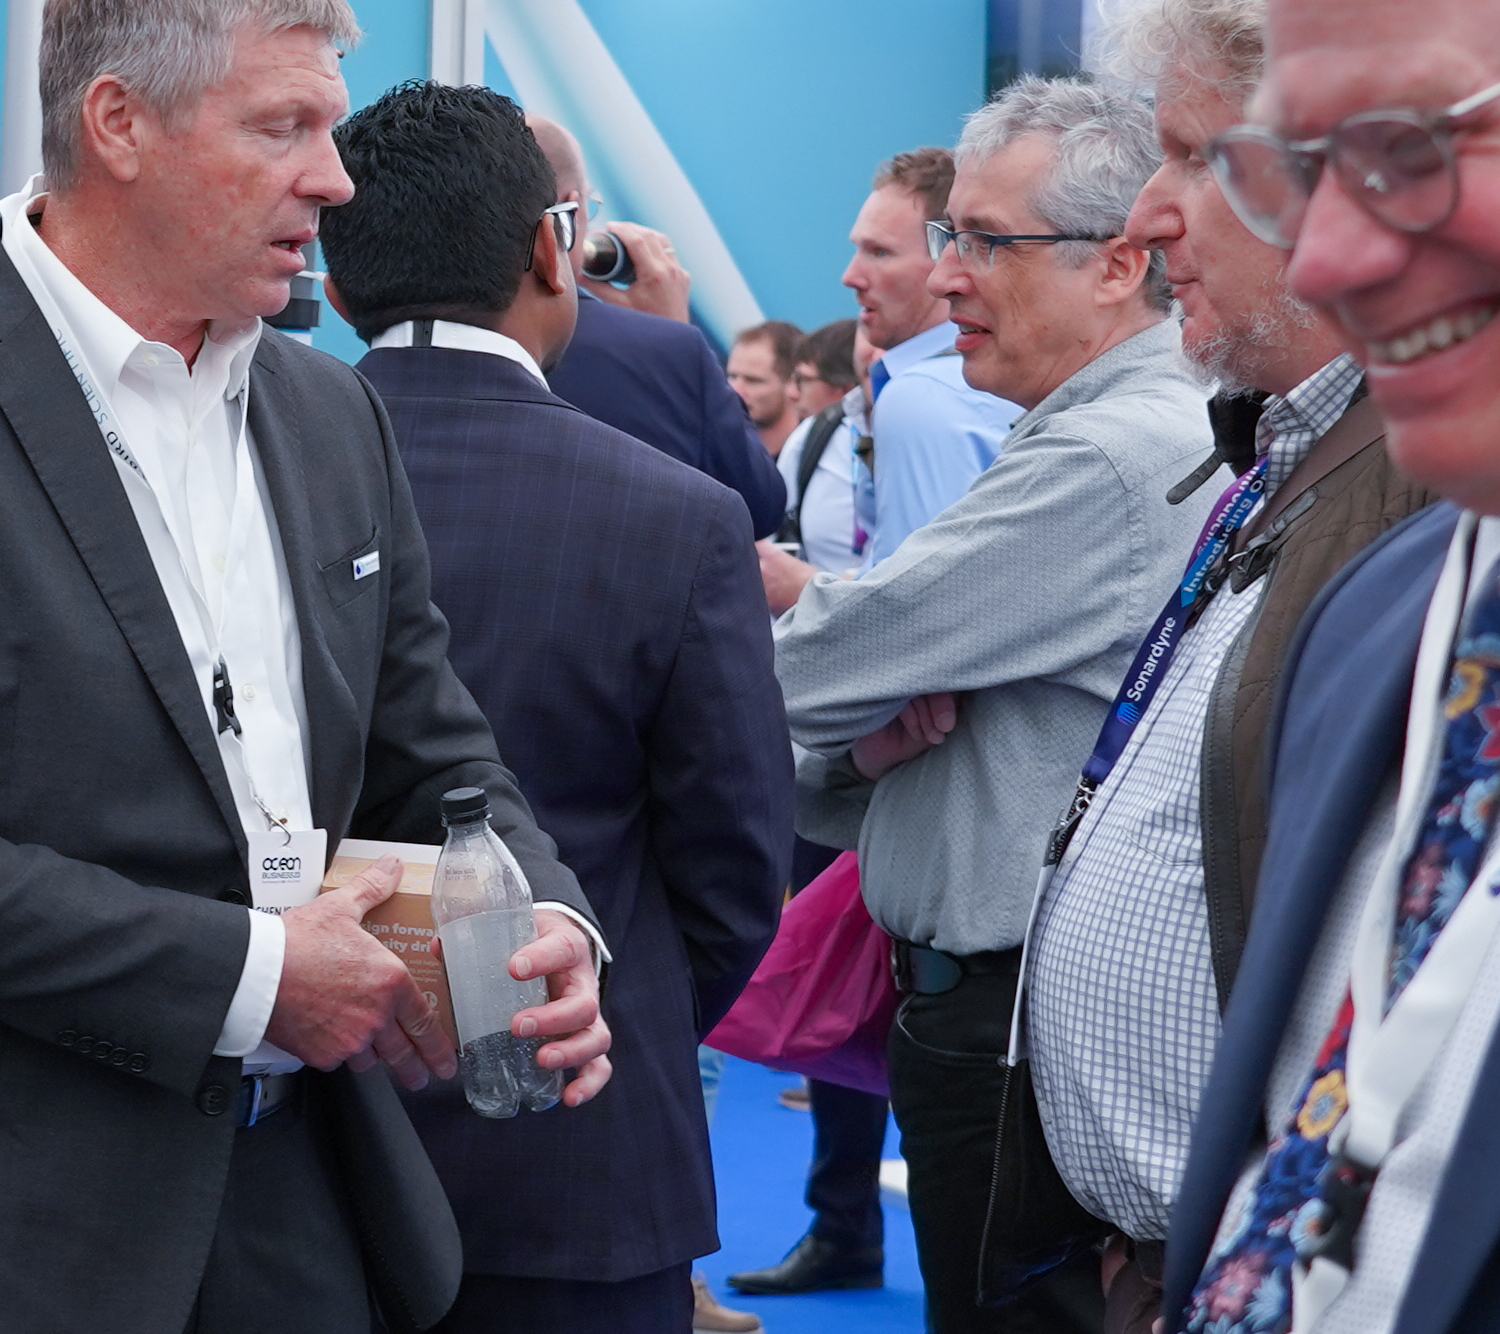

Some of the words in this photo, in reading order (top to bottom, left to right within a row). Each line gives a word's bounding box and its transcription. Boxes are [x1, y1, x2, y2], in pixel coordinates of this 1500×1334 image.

[1183, 498, 1253, 593] Introducing
[1126, 616, 1177, 702] Sonardyne
[262, 856, 302, 871] ocean
[392, 922, 434, 937] forwa
[410, 940, 431, 953] dri
